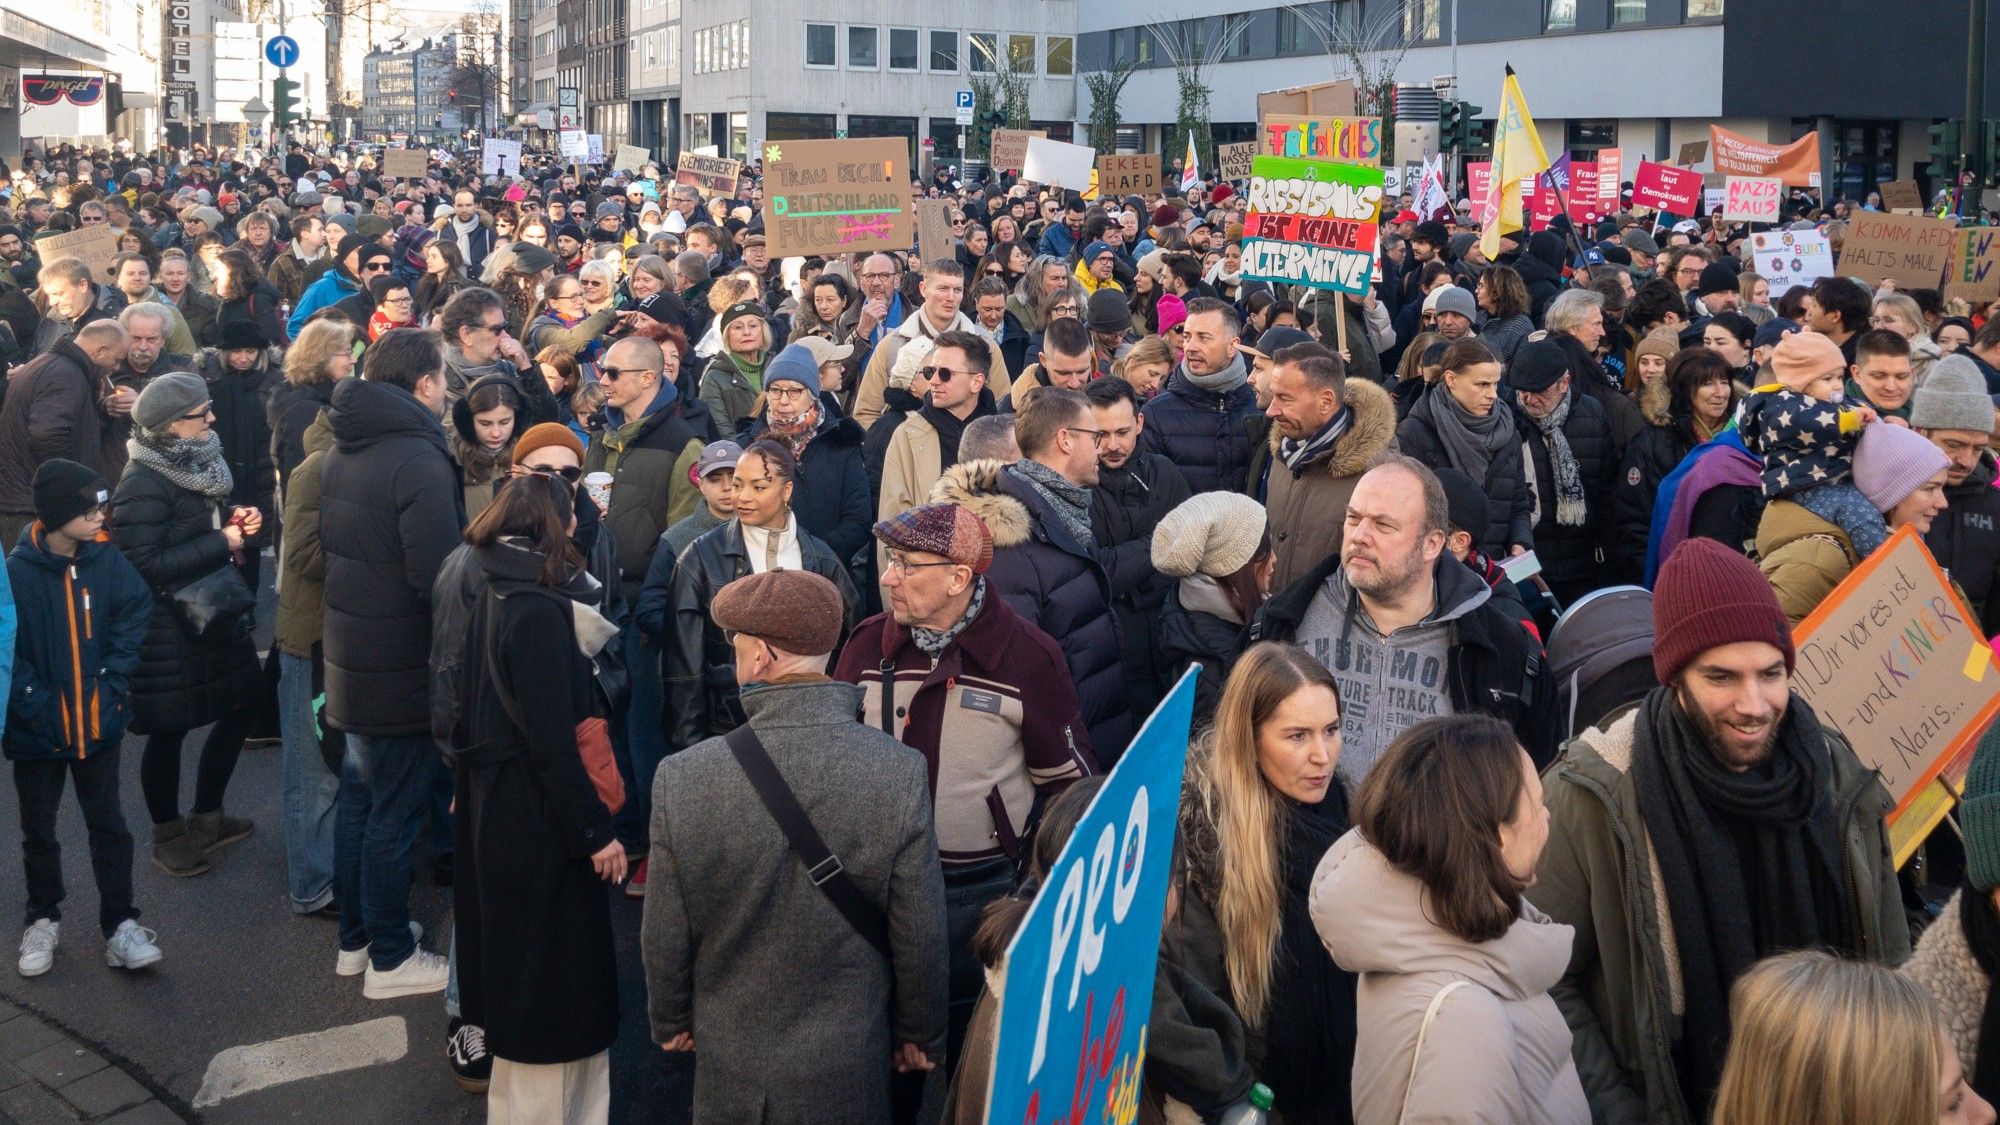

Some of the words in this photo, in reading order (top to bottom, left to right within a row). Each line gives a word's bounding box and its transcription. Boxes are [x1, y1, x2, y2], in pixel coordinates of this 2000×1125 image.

[172, 0, 189, 73] OTEL
[1229, 144, 1255, 155] ALLE
[681, 155, 738, 176] REMIGRIERT
[1106, 156, 1153, 171] EKEL
[1576, 169, 1597, 179] Frau
[1106, 174, 1153, 190] HAFD
[1660, 173, 1678, 185] laut
[773, 192, 900, 215] DEUTSCHLAND
[1246, 176, 1383, 221] RASSISMUS
[1641, 187, 1690, 204] Demokratie!
[1727, 196, 1776, 216] RAUS
[778, 216, 841, 249] FUCK
[1257, 215, 1291, 240] IST
[1298, 218, 1360, 248] KEINE
[1856, 221, 1911, 242] KOMM
[1917, 227, 1951, 247] AFD
[1794, 243, 1824, 255] BUNT
[1844, 248, 1896, 268] HALTS
[1902, 253, 1938, 272] MAUL
[1240, 241, 1370, 289] ALTERNATIVE
[1963, 512, 1994, 531] HH
[1800, 637, 1844, 685] Dir
[1869, 599, 1892, 627] es
[1883, 566, 1916, 607] ist
[1881, 596, 1962, 682] KEINER
[1387, 686, 1438, 715] TRACK
[1027, 784, 1150, 1086] PRO
